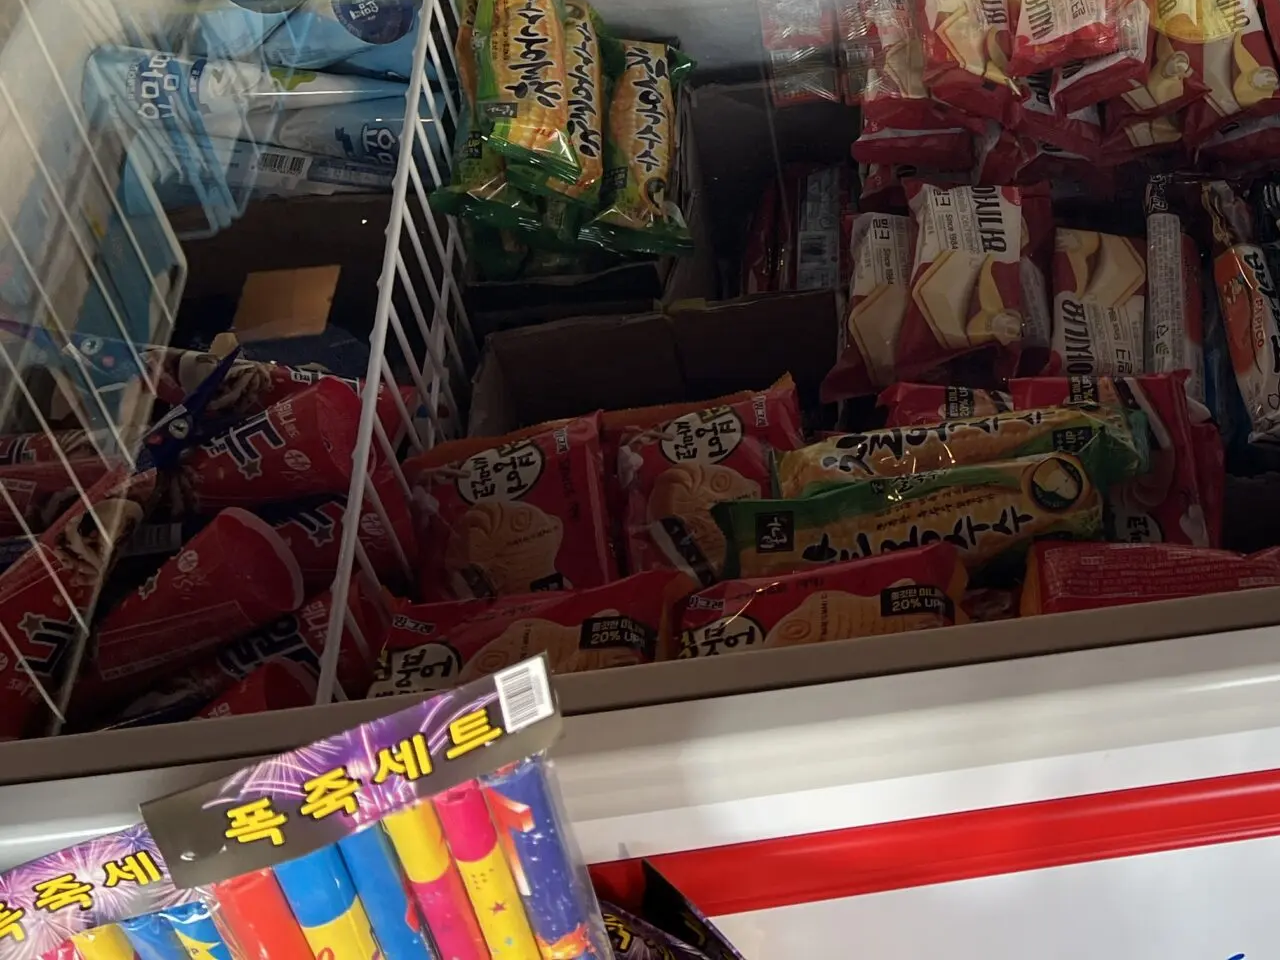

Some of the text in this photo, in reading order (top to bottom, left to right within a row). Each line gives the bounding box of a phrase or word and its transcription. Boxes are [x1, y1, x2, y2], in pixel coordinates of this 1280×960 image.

[891, 600, 922, 613] 20%
[590, 632, 622, 645] 20%
[225, 707, 503, 848] 폭죽세트
